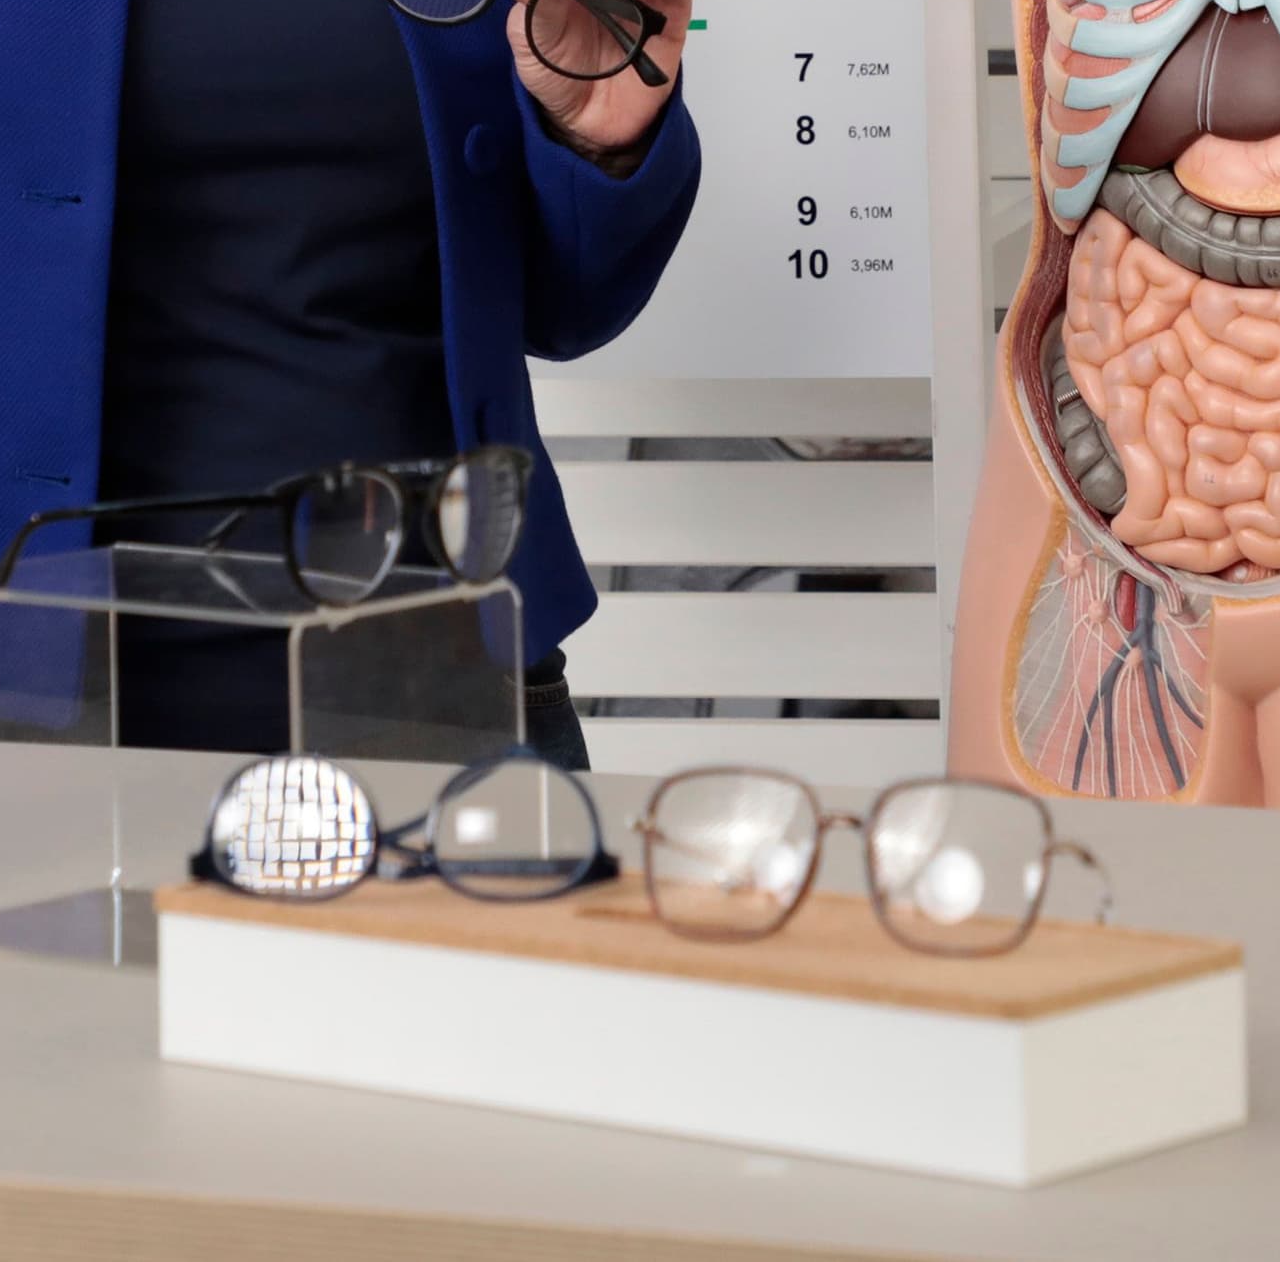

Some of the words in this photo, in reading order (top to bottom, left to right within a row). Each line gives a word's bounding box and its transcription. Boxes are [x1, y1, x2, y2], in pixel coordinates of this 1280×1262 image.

[794, 52, 814, 83] 7
[847, 62, 890, 77] 7,62M
[795, 115, 816, 146] 8
[848, 125, 891, 139] 6,10M
[797, 195, 818, 227] 9
[849, 206, 893, 220] 6,10M
[787, 248, 829, 280] 10
[851, 258, 894, 273] 3,96M
